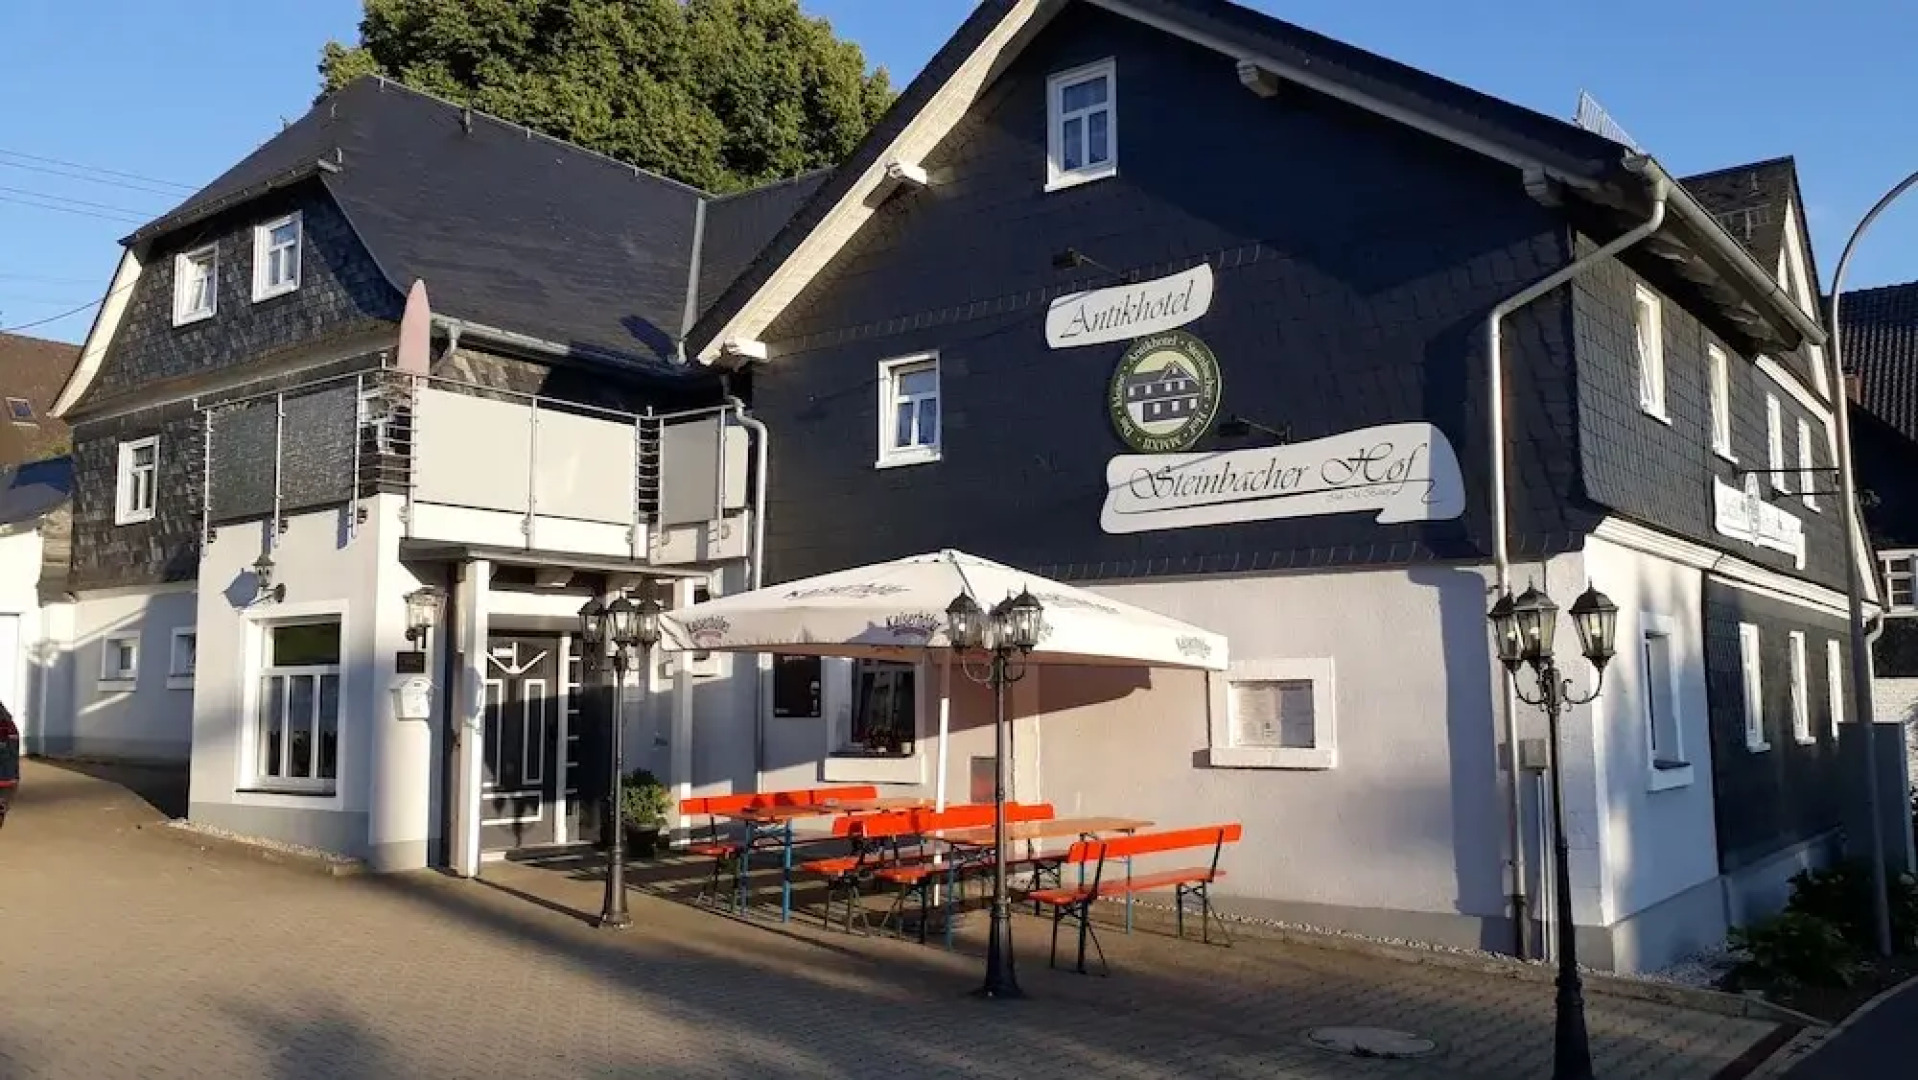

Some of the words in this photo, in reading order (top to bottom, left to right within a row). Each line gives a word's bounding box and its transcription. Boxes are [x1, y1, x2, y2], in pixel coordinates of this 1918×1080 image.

[1059, 279, 1194, 338] Antikhotel
[1129, 457, 1307, 500] Steinbacher
[1321, 442, 1427, 495] Hof
